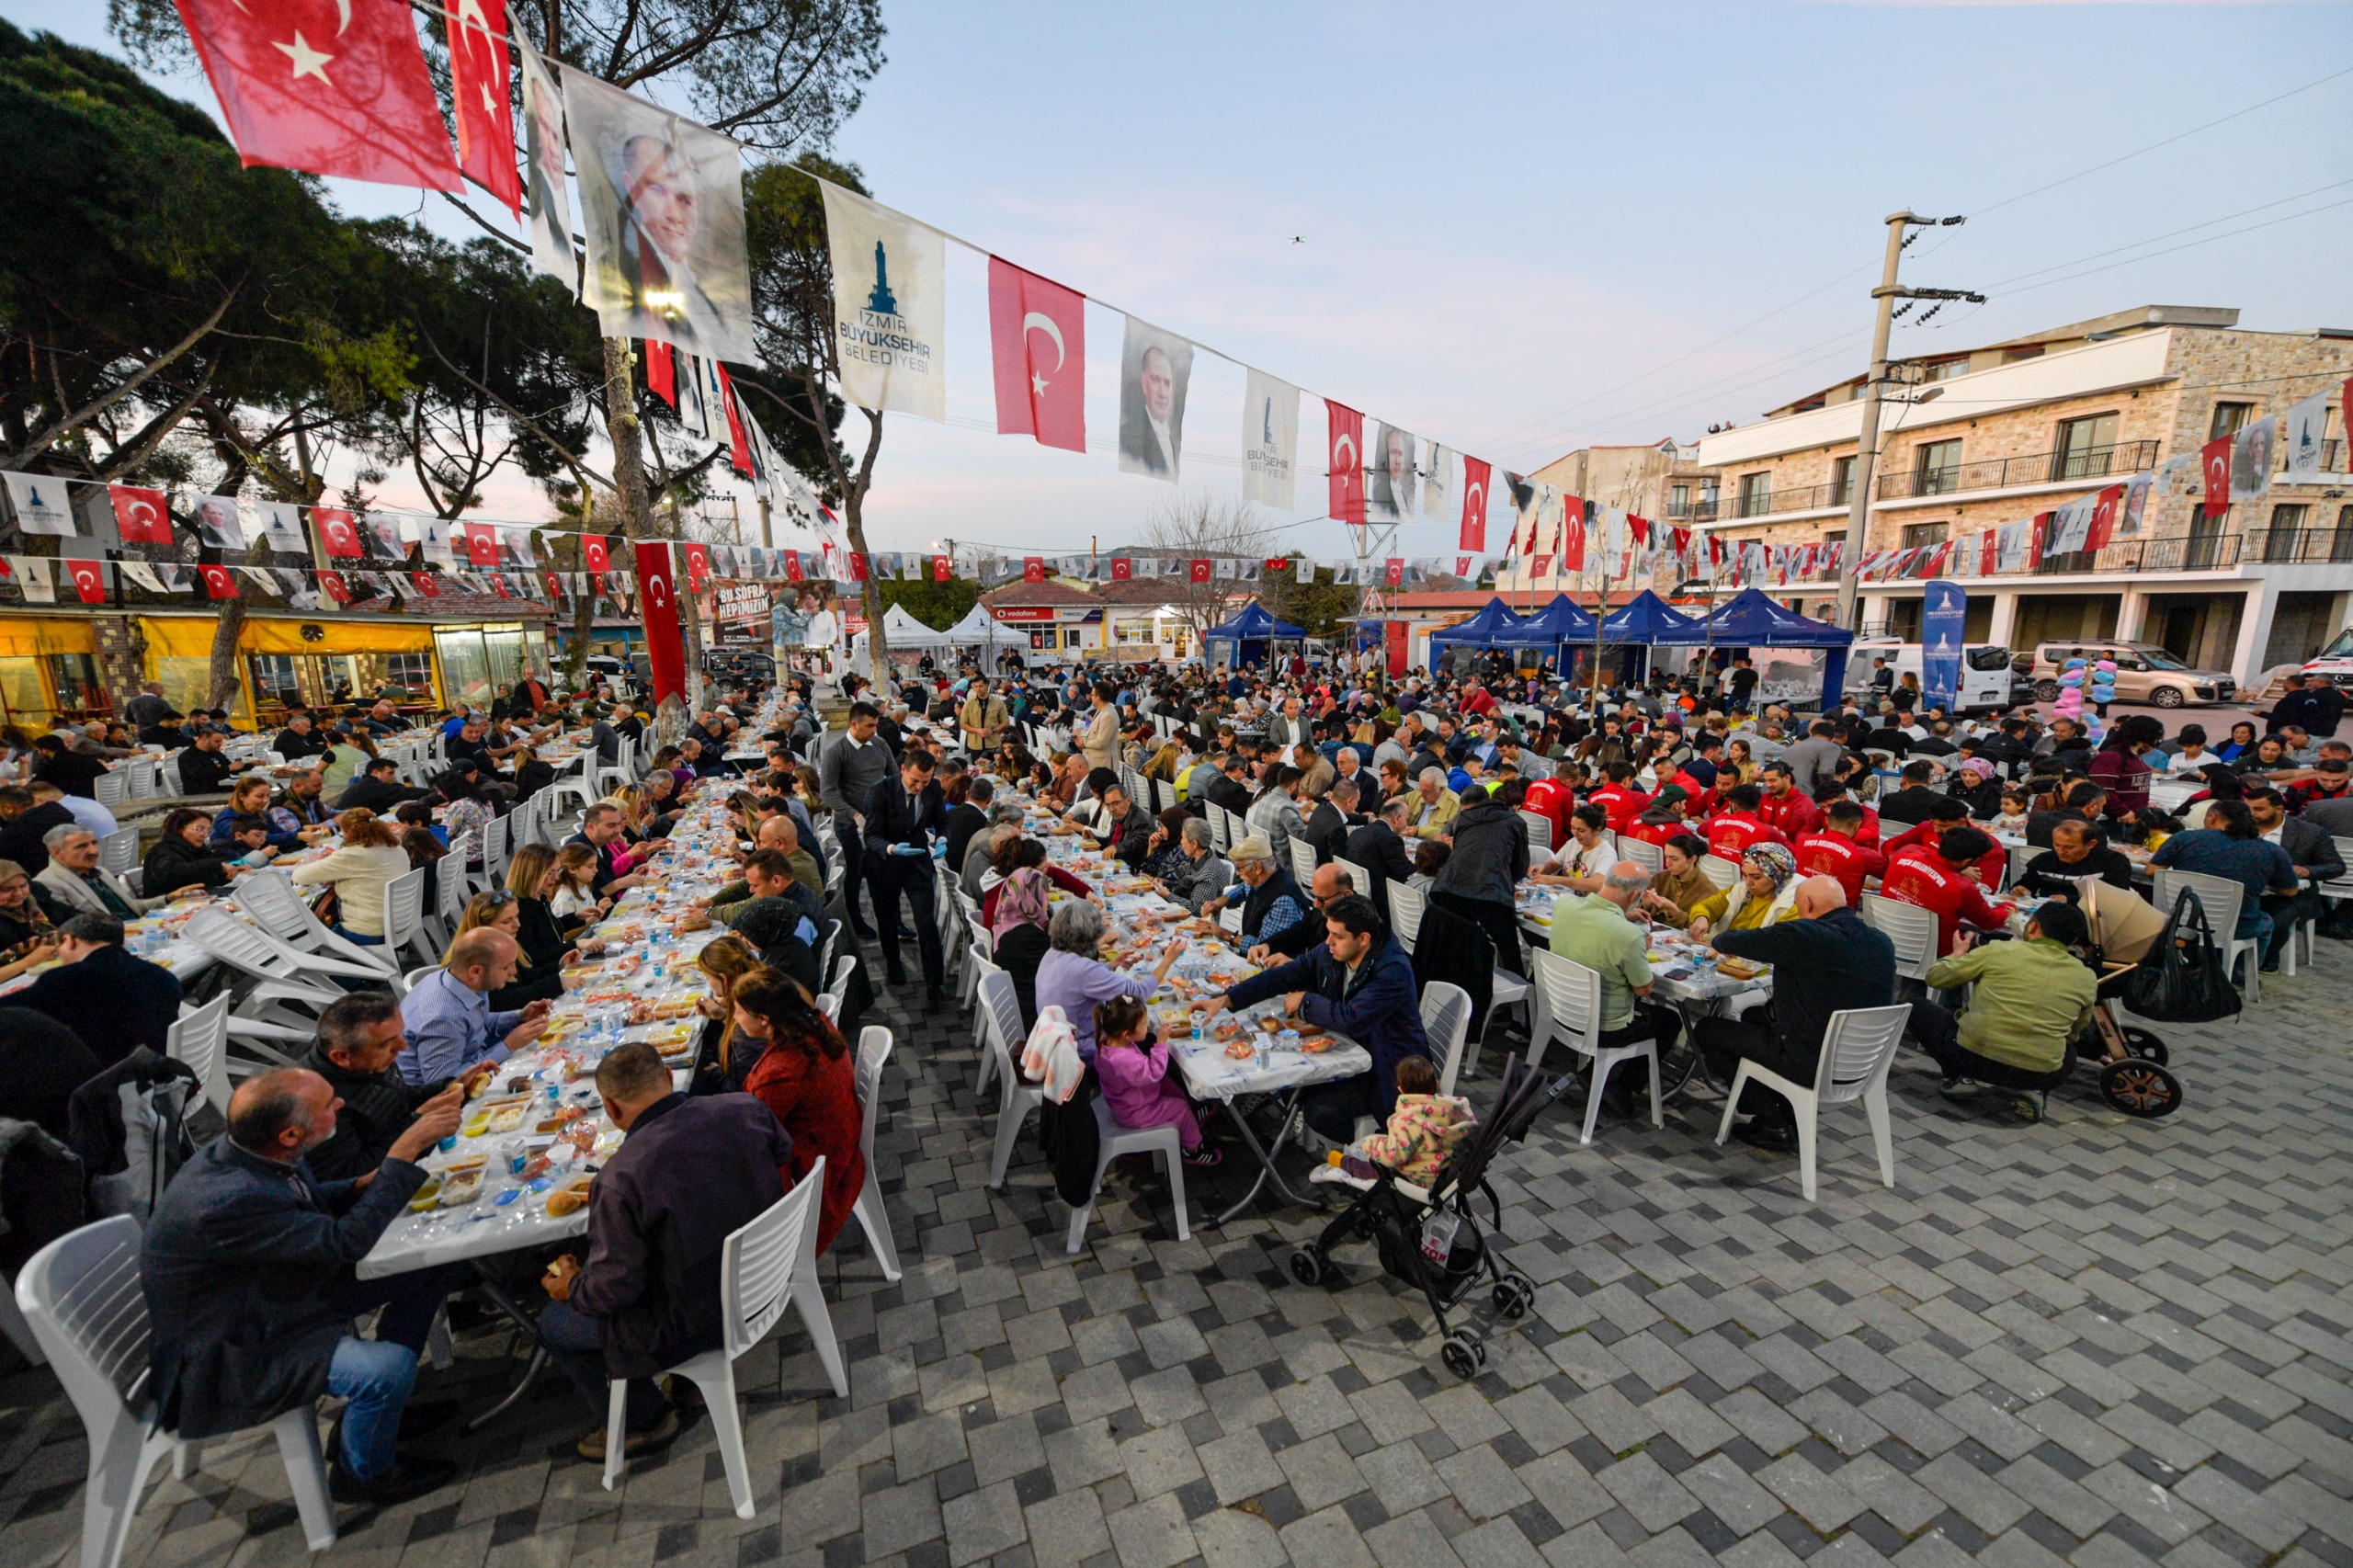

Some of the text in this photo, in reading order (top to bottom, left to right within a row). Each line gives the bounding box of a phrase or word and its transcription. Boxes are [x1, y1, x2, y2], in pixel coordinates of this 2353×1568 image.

[734, 584, 765, 600] SOFRA
[1803, 839, 1819, 847] FOÇA
[1896, 858, 1914, 867] FOÇA
